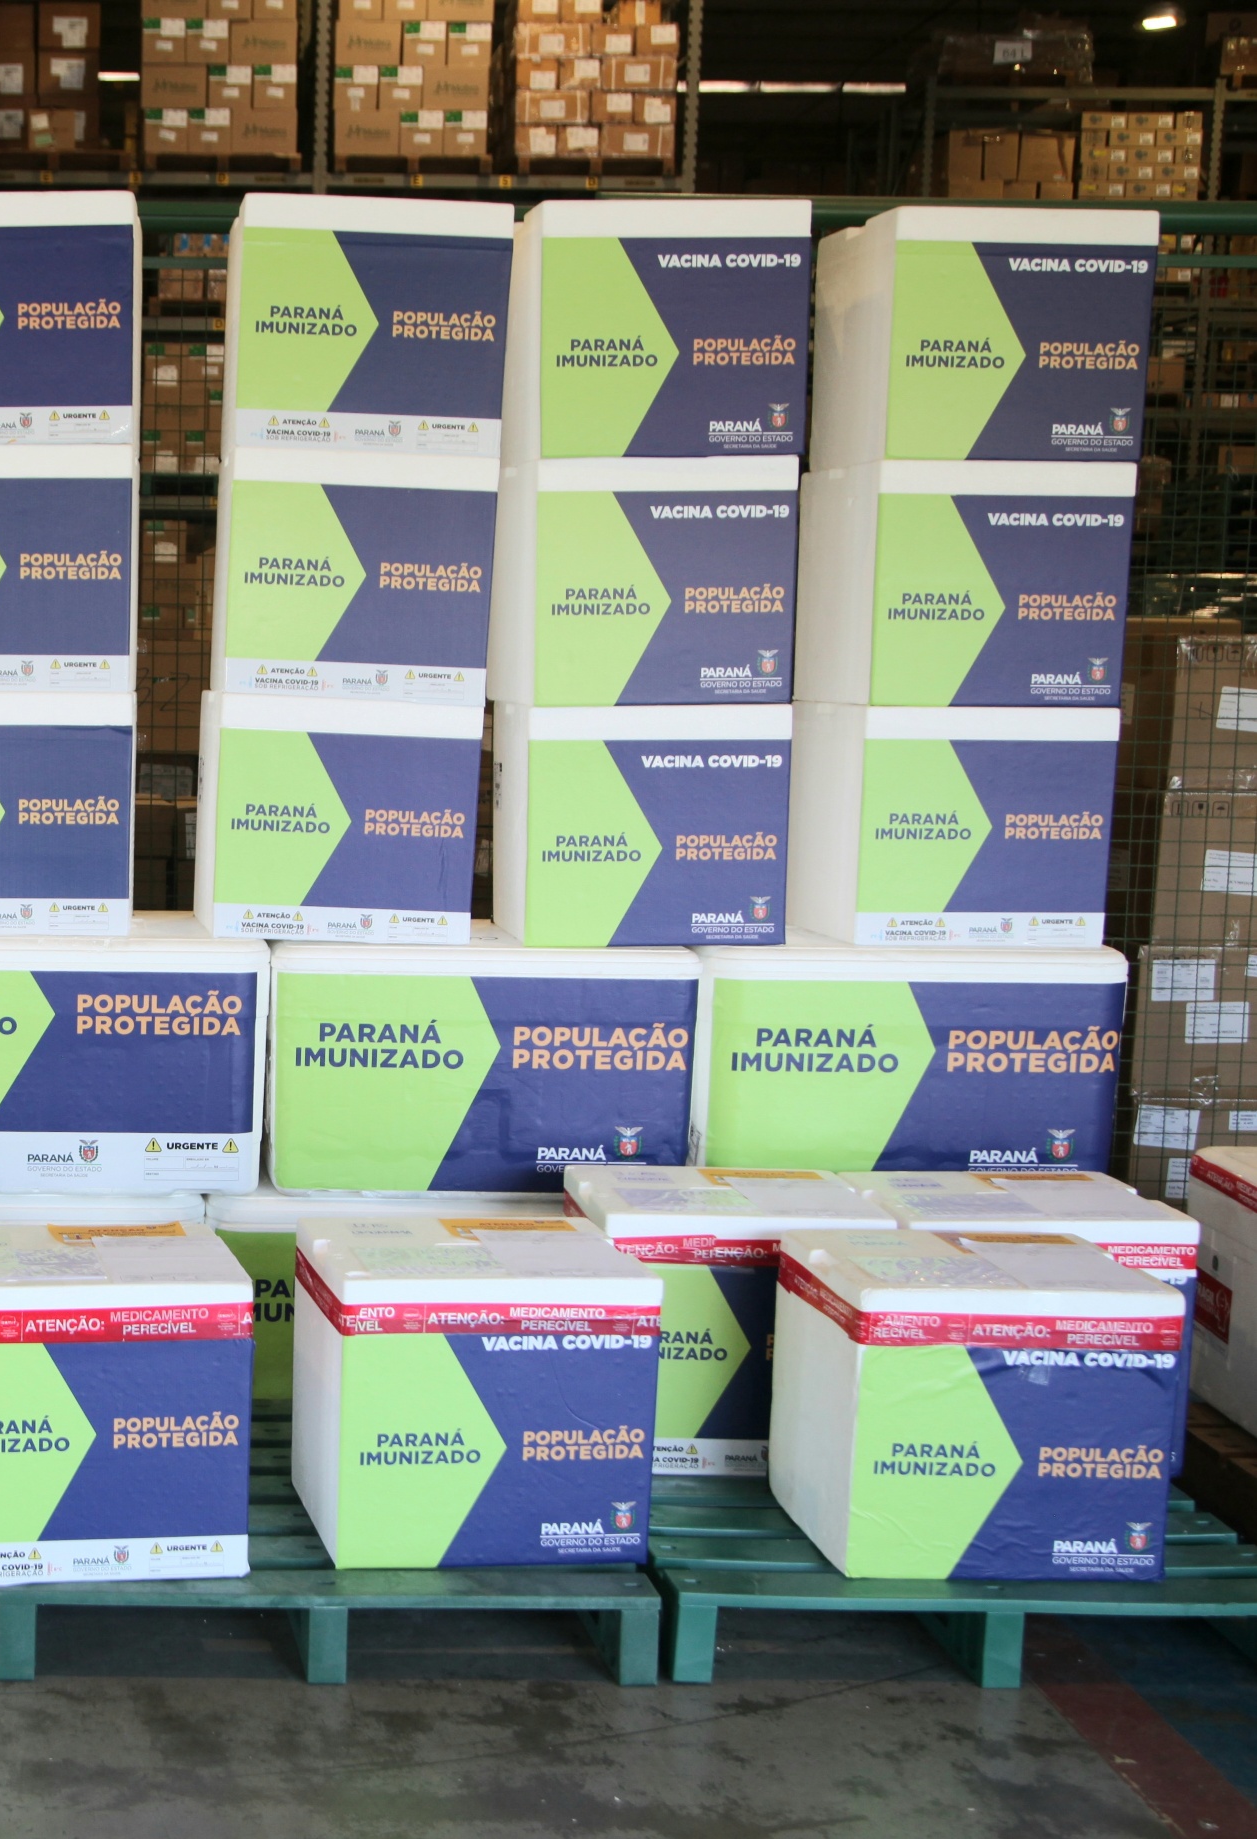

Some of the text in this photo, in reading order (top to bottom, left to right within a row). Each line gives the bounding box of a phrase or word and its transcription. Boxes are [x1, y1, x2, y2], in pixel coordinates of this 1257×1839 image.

[1009, 258, 1148, 273] VACINA COVID-19
[18, 299, 121, 319] POPULAÇÃO
[18, 313, 120, 328] PROTEGIDA
[393, 311, 496, 330] POPULAÇÃO
[393, 324, 494, 340] PROTEGIDA
[921, 338, 991, 352] PARANÁ
[906, 355, 1004, 368] IMUNIZADO
[651, 505, 789, 518] VACINA COVID-19
[20, 551, 122, 570] POPULAÇÃO
[20, 563, 120, 579] PROTEGIDA
[380, 562, 482, 581] POPULAÇÃO
[380, 574, 480, 591] PROTEGIDA
[566, 585, 636, 600] PARANÁ
[552, 603, 650, 615] IMUNIZADO
[642, 755, 782, 767] VACINA COVID-19
[890, 811, 958, 825] PARANÁ
[1006, 812, 1104, 830] POPULAÇÃO
[876, 828, 971, 840] IMUNIZADO
[1006, 823, 1101, 839] PROTEGIDA
[676, 832, 778, 851] POPULAÇÃO
[676, 845, 776, 860] PROTEGIDA
[77, 990, 242, 1019] POPULAÇÃO
[77, 1012, 240, 1035] PROTEGIDA
[320, 1020, 441, 1043] PARANÁ
[514, 1023, 689, 1052] POPULAÇÃO
[757, 1024, 876, 1047] PARANÁ
[949, 1026, 1122, 1056] POPULAÇÃO
[296, 1048, 463, 1069] IMUNIZADO
[513, 1046, 686, 1070] PROTEGIDA
[732, 1052, 898, 1073] IMUNIZADO
[948, 1049, 1115, 1072] PROTEGIDA
[167, 1142, 218, 1150] URGENTE
[538, 1145, 606, 1162] PARANÁ
[28, 1153, 73, 1162] PARANÁ
[970, 1147, 1038, 1164] PARANÁ
[1106, 1244, 1195, 1258] MEDICAMENTO
[1117, 1255, 1183, 1269] PERECÍVEL
[111, 1308, 208, 1325] MEDICAMENTO
[428, 1310, 504, 1327] ATENÇÃO:
[510, 1307, 605, 1319] MEDICAMENTO
[26, 1317, 104, 1334] ATENÇÃO:
[123, 1320, 196, 1335] PERECÍVEL
[521, 1317, 591, 1331] PERECÍVEL
[973, 1322, 1050, 1339] ATENÇÃO:
[1056, 1318, 1152, 1334] MEDICAMENTO
[482, 1335, 652, 1351] VACINA COVID-19
[1067, 1331, 1138, 1345] PERECÍVEL
[1003, 1348, 1175, 1368] VACINA COVID-19
[114, 1412, 239, 1436] POPULAÇÃO
[114, 1429, 238, 1448] PROTEGIDA
[378, 1429, 464, 1447] PARANÁ
[523, 1426, 645, 1449] POPULAÇÃO
[360, 1446, 480, 1465] IMUNIZADO
[523, 1441, 643, 1460] PROTEGIDA
[892, 1443, 979, 1458] PARANÁ
[1040, 1446, 1164, 1467] POPULAÇÃO
[874, 1461, 995, 1477] IMUNIZADO
[1039, 1461, 1161, 1478] PROTEGIDA
[542, 1519, 603, 1536] PARANÁ
[541, 1534, 640, 1546] GOVERNO DO ESTADO
